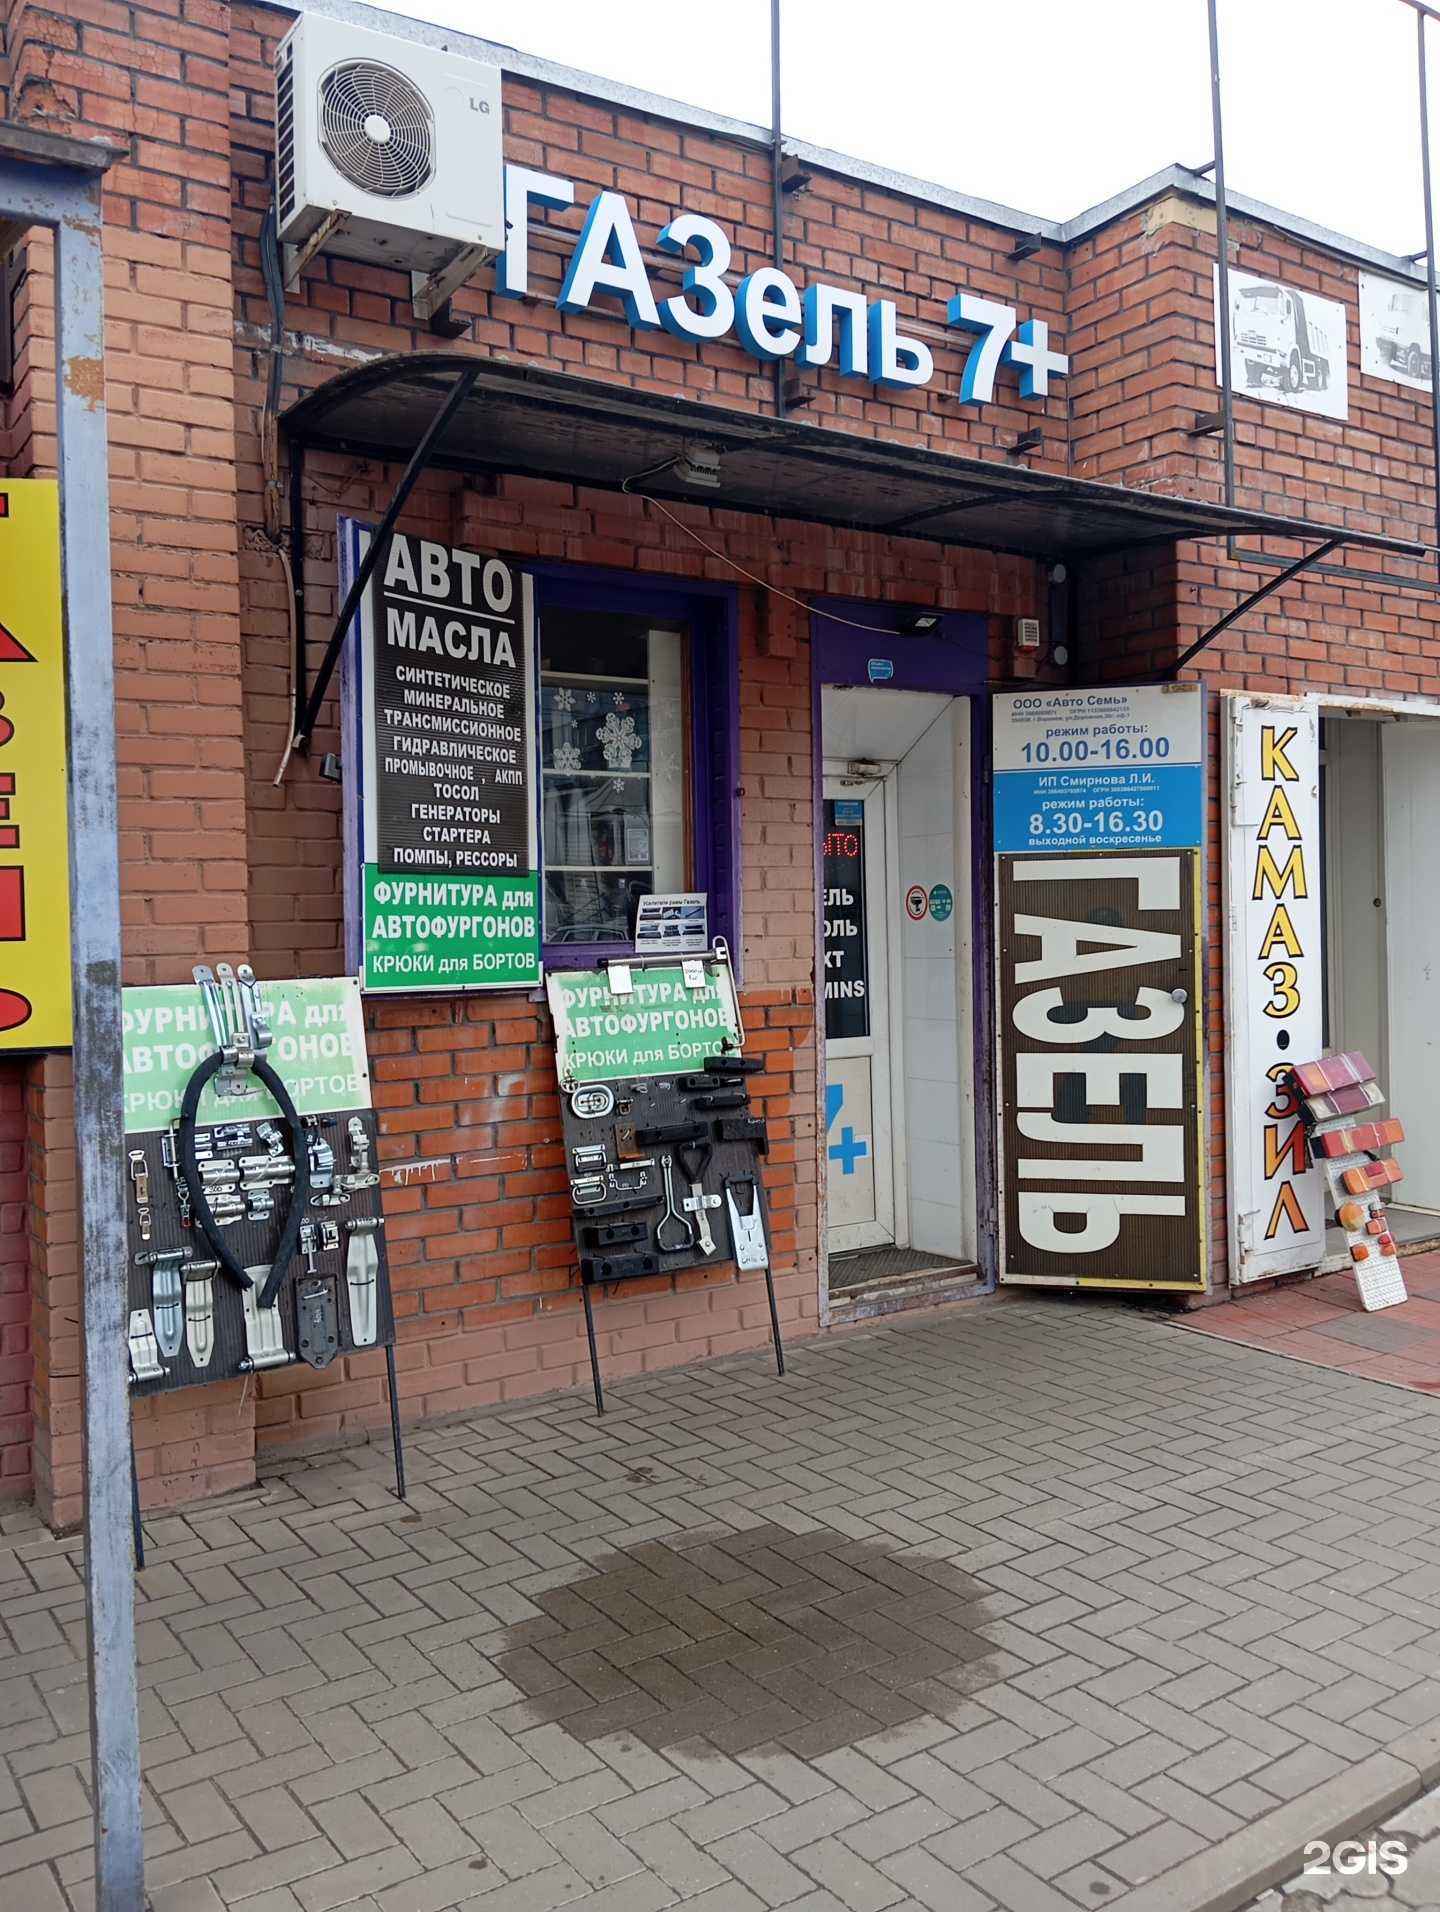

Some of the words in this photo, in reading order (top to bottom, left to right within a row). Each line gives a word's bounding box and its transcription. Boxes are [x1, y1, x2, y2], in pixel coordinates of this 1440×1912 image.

[470, 97, 489, 114] LG
[498, 164, 934, 388] ГАЗель
[947, 292, 1068, 407] 7+
[384, 533, 513, 612] АВТО
[387, 608, 516, 668] МАСЛА
[396, 665, 511, 699] СИНТЕТИЧЕСКОЕ
[404, 689, 505, 718] МИНЕРАЛЬНОЕ
[1013, 698, 1042, 709] ООО
[1046, 697, 1083, 707] «Авто
[1087, 695, 1127, 705] Семь»
[384, 709, 521, 742] ТРАНСМИССИОННОЕ
[1046, 726, 1089, 738] режим
[1093, 723, 1148, 738] работы:
[393, 735, 517, 764] ГИДРАВЛИЧЕСКОЕ
[1021, 736, 1170, 763] 10.00-16.00
[495, 769, 523, 785] АКПП
[1039, 776, 1057, 787] ИП
[1060, 774, 1125, 788] Смирнова
[1129, 773, 1155, 784] Л.И.
[434, 783, 480, 801] ТОСОЛ
[411, 804, 501, 824] ГЕНЕРАТОРЫ
[1042, 800, 1085, 811] режим
[1089, 797, 1144, 809] работы:
[1029, 810, 1164, 834] 8.30-16.30
[423, 827, 491, 844] СТАРТЕРА
[1029, 834, 1086, 846] выходной
[1089, 834, 1162, 845] воскресенье
[394, 847, 452, 868] ПОМПЫ,
[456, 851, 518, 868] РЕССОРЫ
[373, 881, 497, 907] ФУРНИТУРА
[502, 891, 534, 910] для
[372, 914, 536, 939] АВТОФУРГОНОВ
[373, 954, 434, 973] КРЮКИ
[438, 957, 468, 973] для
[473, 952, 536, 970] БОРТОВ
[633, 1050, 664, 1065] для
[1012, 857, 1187, 1253] ГАЗЕЛЬ
